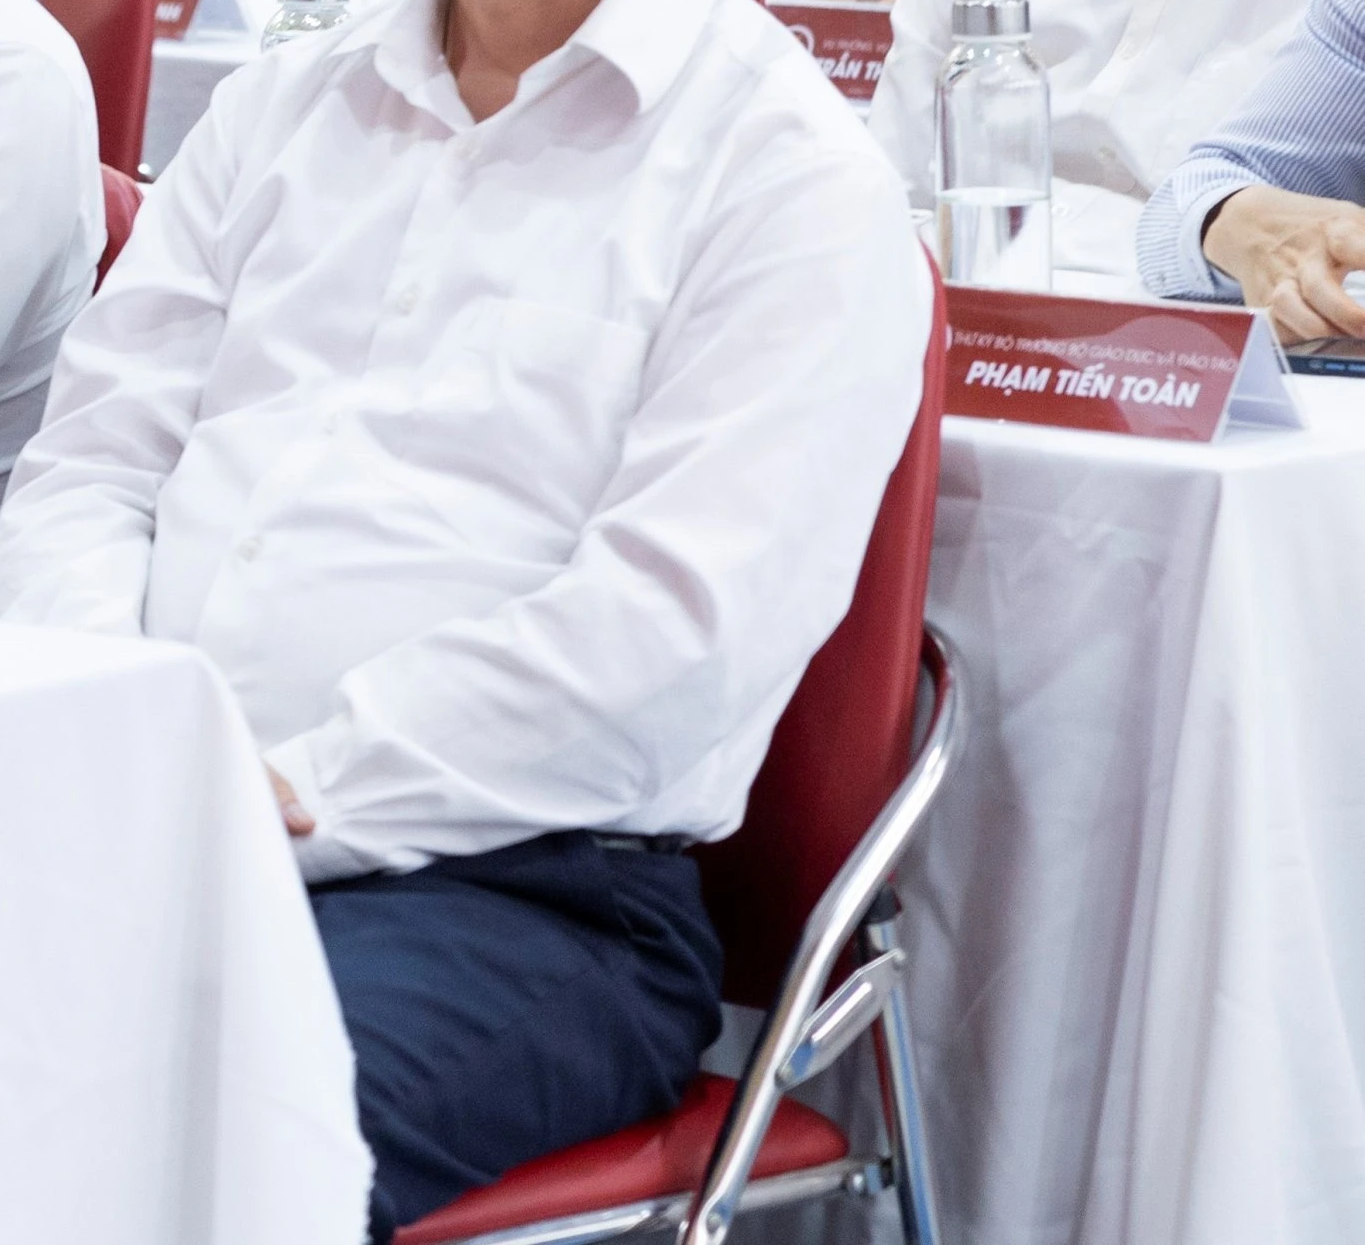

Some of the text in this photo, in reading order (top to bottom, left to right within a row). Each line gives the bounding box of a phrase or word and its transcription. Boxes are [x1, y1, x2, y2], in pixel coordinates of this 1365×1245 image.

[993, 334, 1015, 351] BỘ
[965, 359, 1201, 408] PHẠM TIẾN TOÀN
